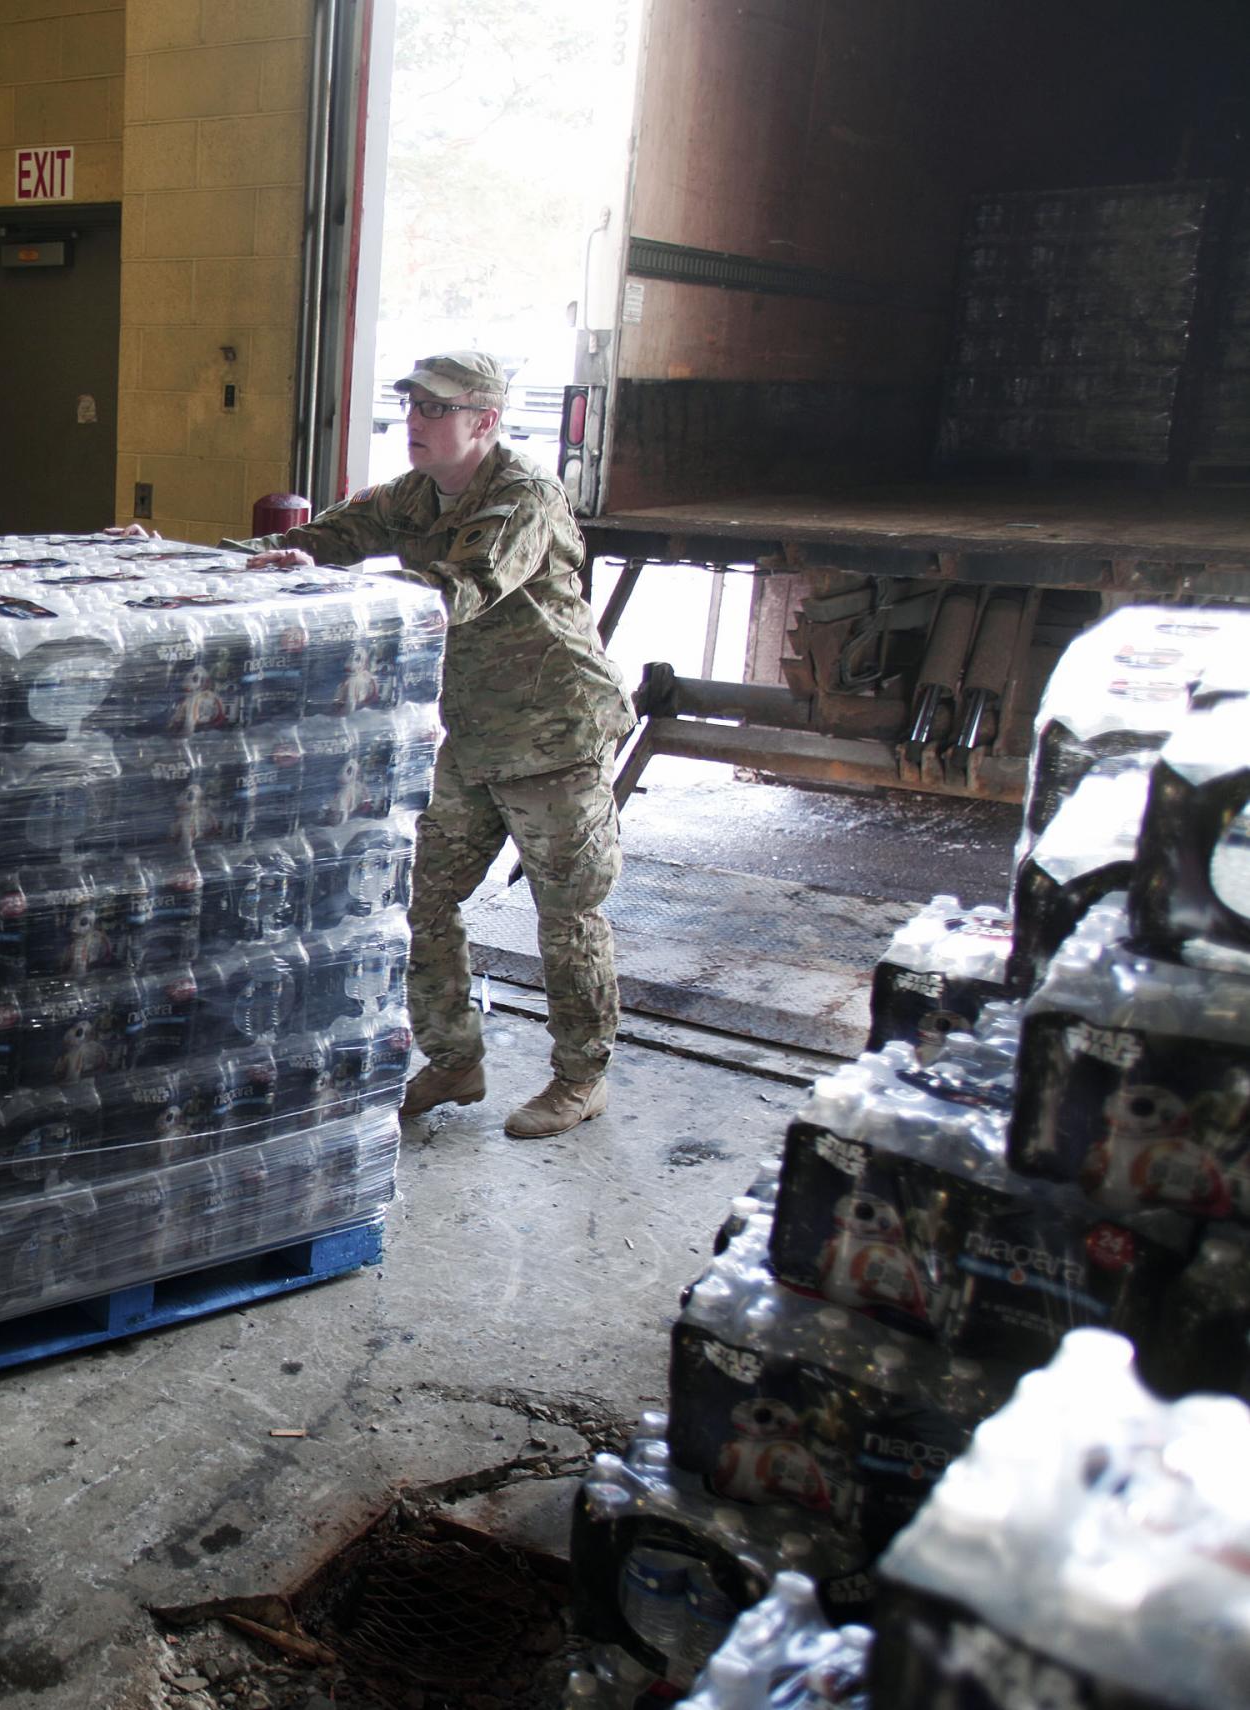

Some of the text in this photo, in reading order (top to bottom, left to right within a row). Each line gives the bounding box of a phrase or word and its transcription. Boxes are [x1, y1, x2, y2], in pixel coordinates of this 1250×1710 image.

[18, 150, 71, 198] EXIT
[893, 980, 943, 998] WARS
[896, 972, 943, 988] STAR
[1064, 1034, 1141, 1069] WARS
[1065, 1022, 1142, 1052] STAR
[815, 1142, 866, 1175] WARS
[816, 1133, 867, 1163] STAR
[1097, 1230, 1125, 1253] 24
[964, 1231, 1086, 1286] niagara
[702, 1340, 764, 1371] STAR
[704, 1346, 762, 1384] WARS
[864, 1432, 949, 1467] niaga
